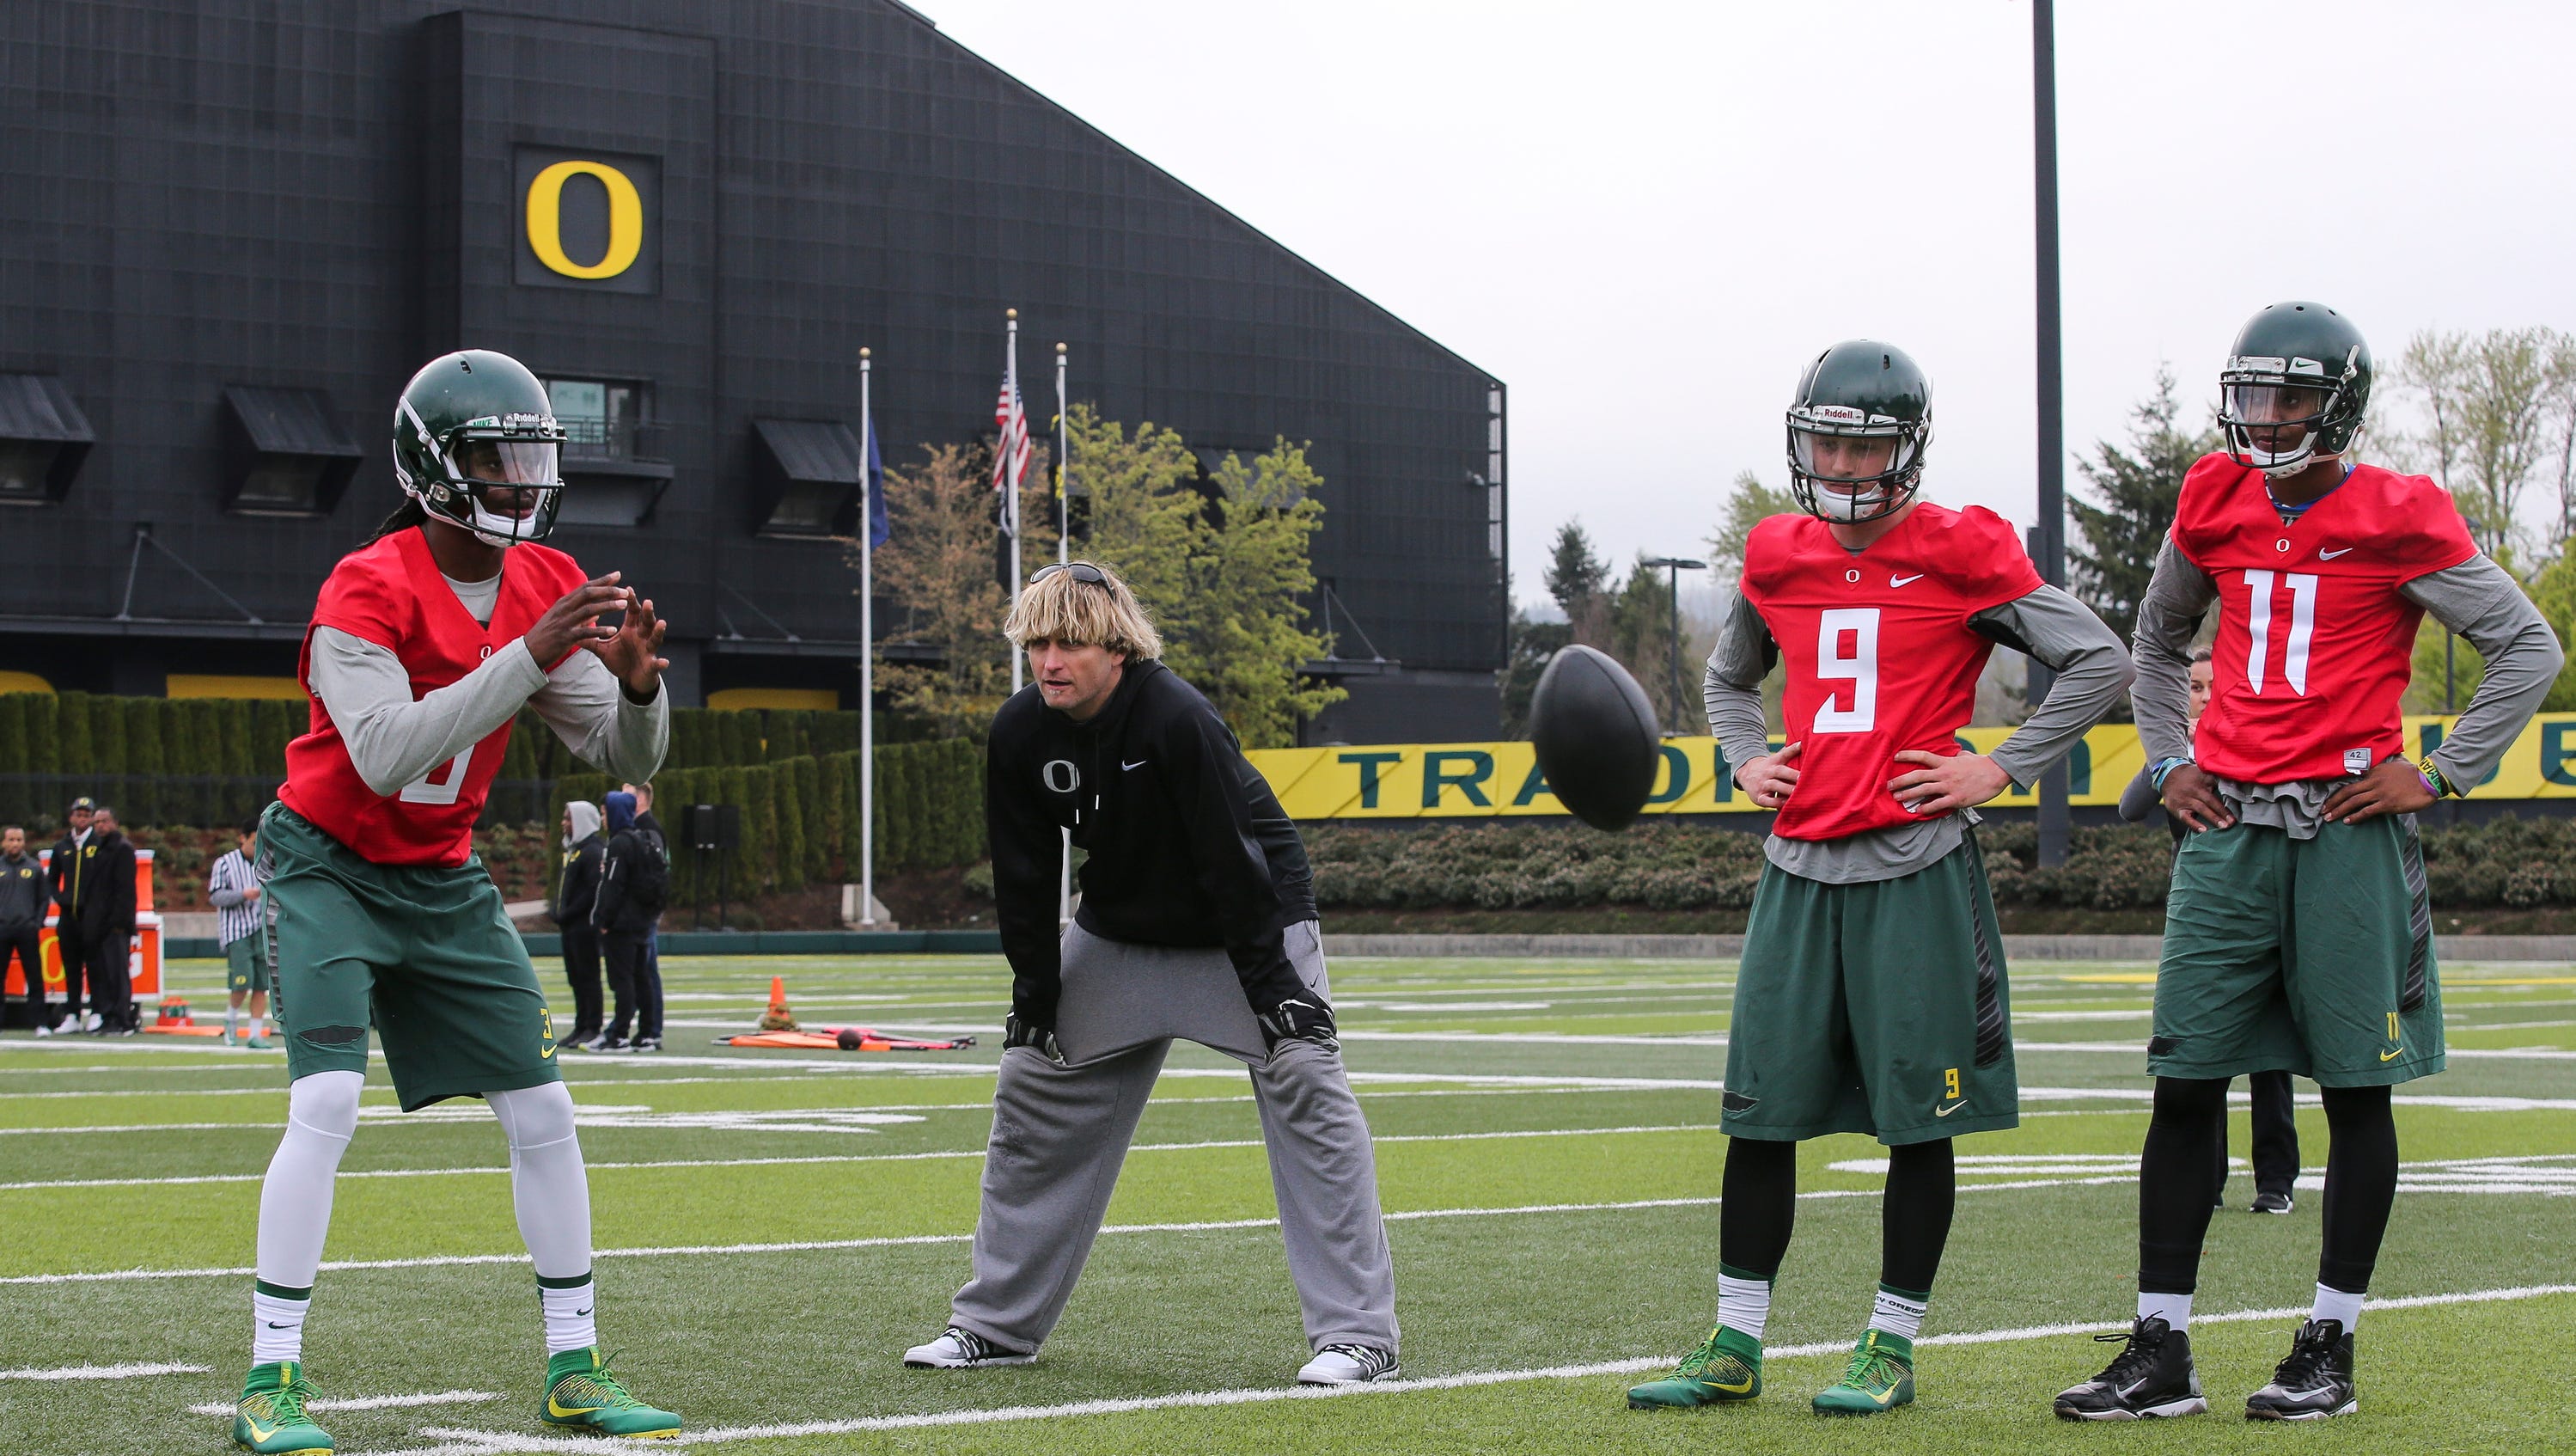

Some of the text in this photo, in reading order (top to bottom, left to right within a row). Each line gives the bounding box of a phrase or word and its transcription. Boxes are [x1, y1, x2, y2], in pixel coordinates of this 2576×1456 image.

[526, 160, 644, 279] O
[473, 418, 493, 427] NIKE
[514, 413, 540, 423] Riddell
[1824, 408, 1853, 419] Riddell
[2276, 538, 2291, 553] O
[1845, 569, 1860, 583] O
[2243, 568, 2319, 697] 11
[1812, 607, 1881, 734] 9
[2349, 750, 2362, 759] 42
[1042, 759, 1081, 792] O
[540, 1007, 553, 1039] 3
[2386, 1012, 2400, 1042] 11
[1944, 1068, 1960, 1099] 9
